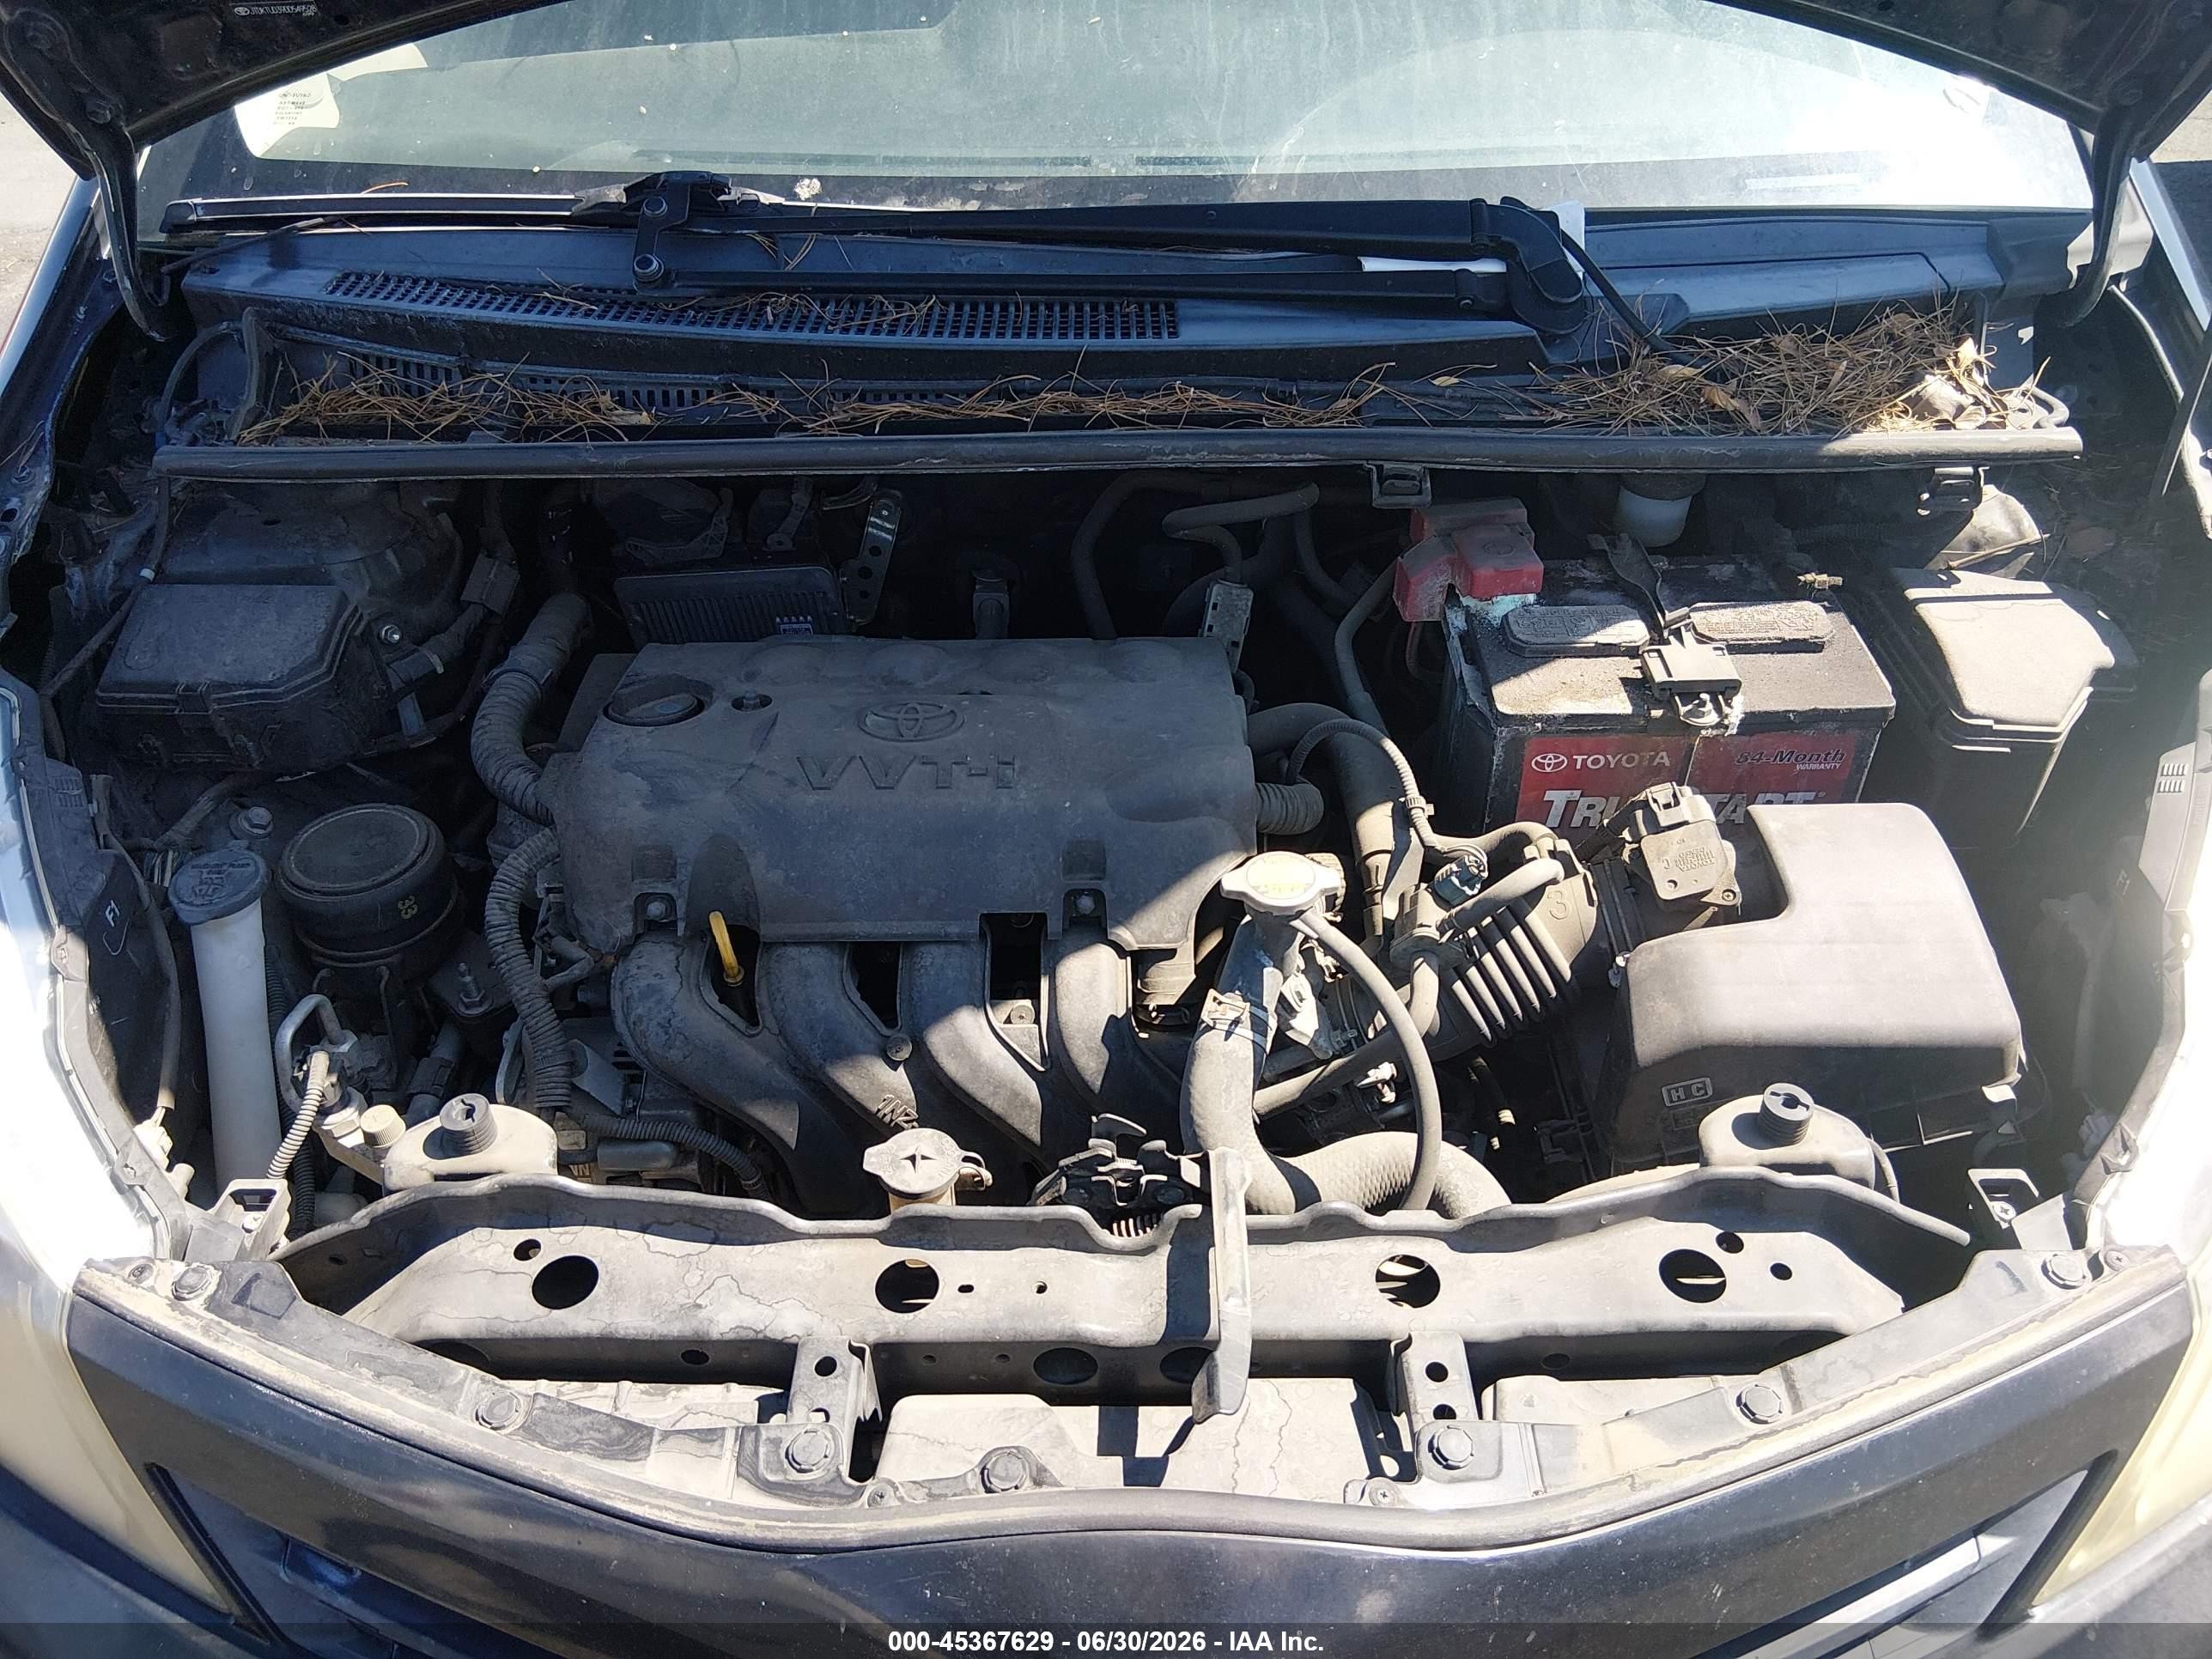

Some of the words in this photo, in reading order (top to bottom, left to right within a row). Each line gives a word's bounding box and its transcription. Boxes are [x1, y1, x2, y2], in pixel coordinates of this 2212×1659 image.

[1573, 751, 1670, 769] TOYOTA
[1735, 749, 1846, 764] 84-Month
[796, 755, 1015, 790] VVT-i
[1675, 859, 1715, 872] TOYOTA
[1547, 890, 1569, 921] 3
